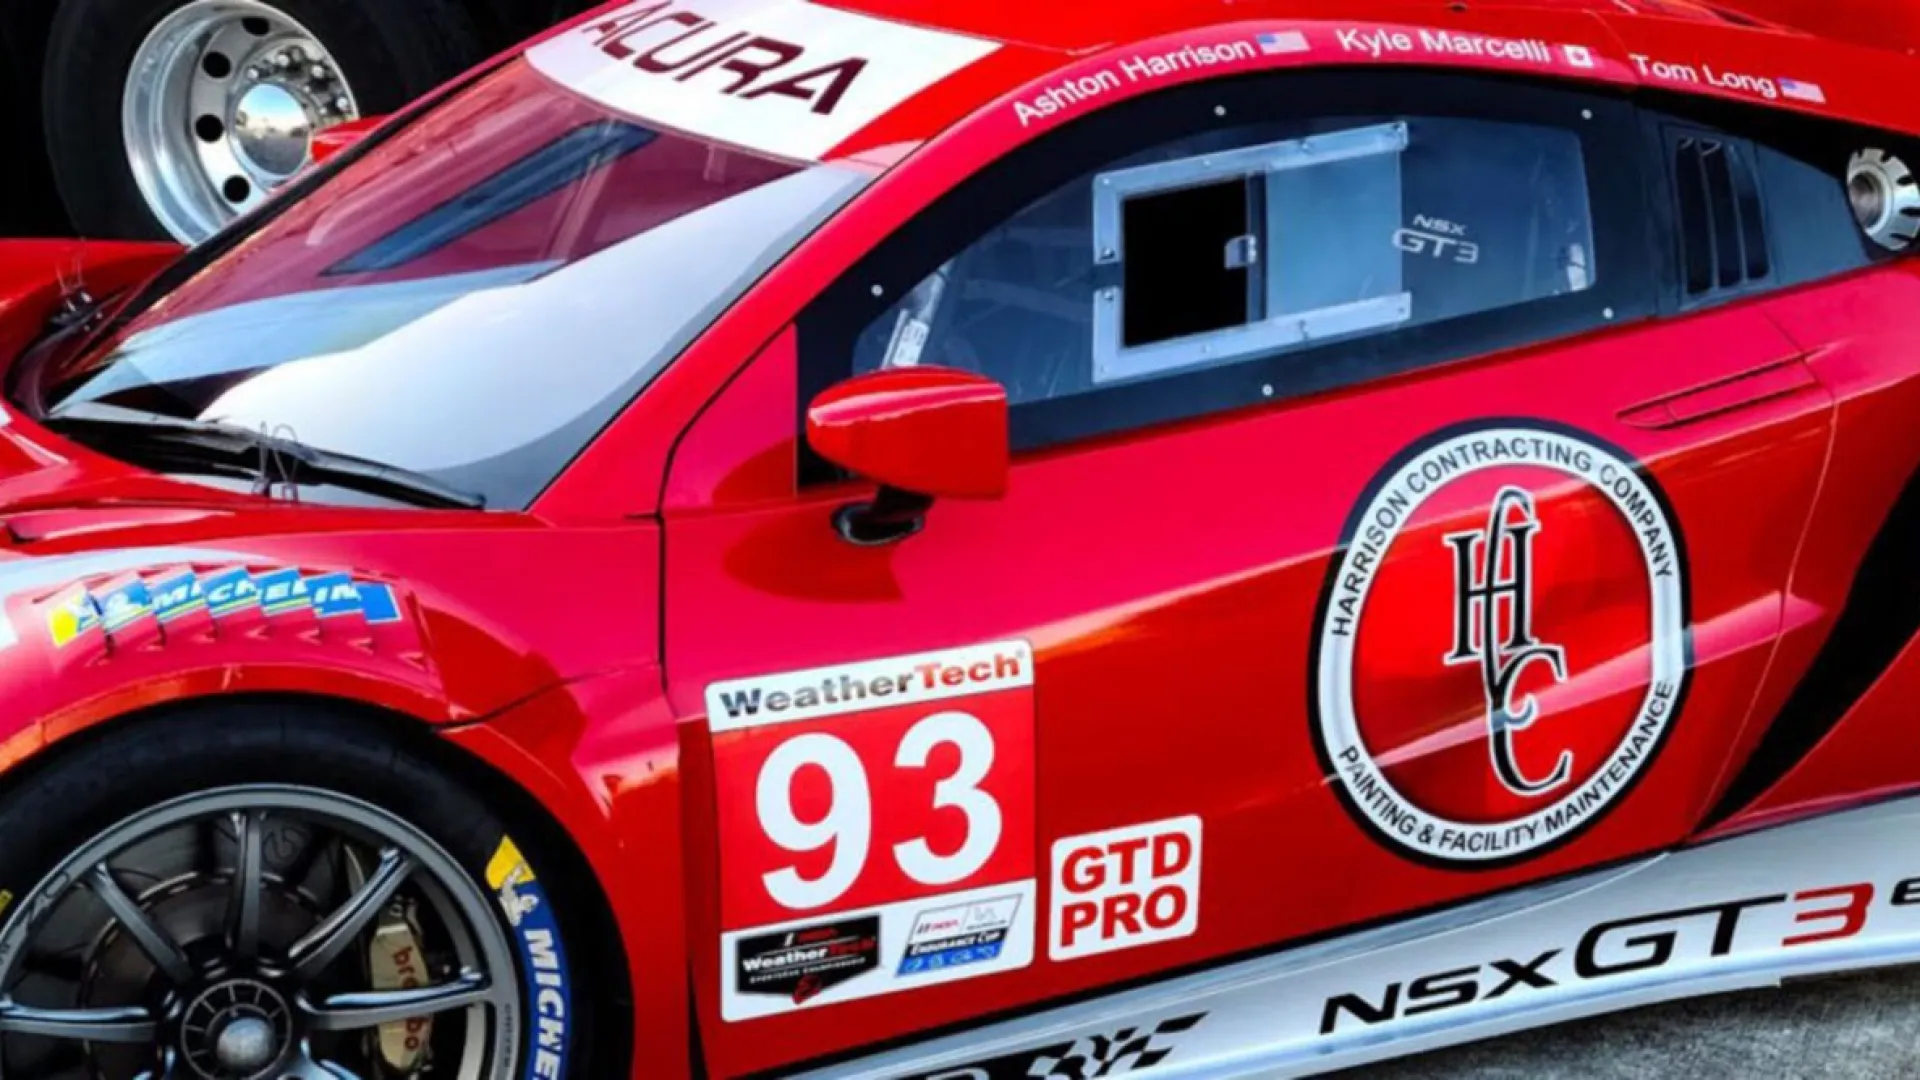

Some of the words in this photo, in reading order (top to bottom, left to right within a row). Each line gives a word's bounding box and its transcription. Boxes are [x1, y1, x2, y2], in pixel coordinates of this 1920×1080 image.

[581, 0, 868, 115] ACURA
[1013, 69, 1121, 127] Ashton
[1119, 40, 1256, 82] Harrison
[1335, 28, 1411, 58] Kyle
[1418, 29, 1551, 63] Marcelli
[1628, 53, 1699, 83] Tom
[1702, 64, 1778, 99] Long
[1391, 228, 1479, 263] GT3
[1413, 214, 1466, 235] NSX
[1332, 489, 1409, 636] HARRISON
[1406, 437, 1593, 494] CONTRACTING
[1599, 464, 1673, 579] COMPANY
[719, 652, 1021, 718] WeatherTech
[1338, 745, 1416, 836] PAINTING
[1417, 822, 1436, 845] &
[1438, 820, 1540, 855] FACILITY
[1544, 681, 1675, 833] MAINTENANCE
[755, 711, 1003, 911] 93
[1061, 831, 1192, 894] GTD
[1060, 884, 1187, 948] PRO
[1319, 949, 1563, 1034] NSX
[1574, 883, 1875, 978] GT3
[523, 928, 564, 1080] MICHE
